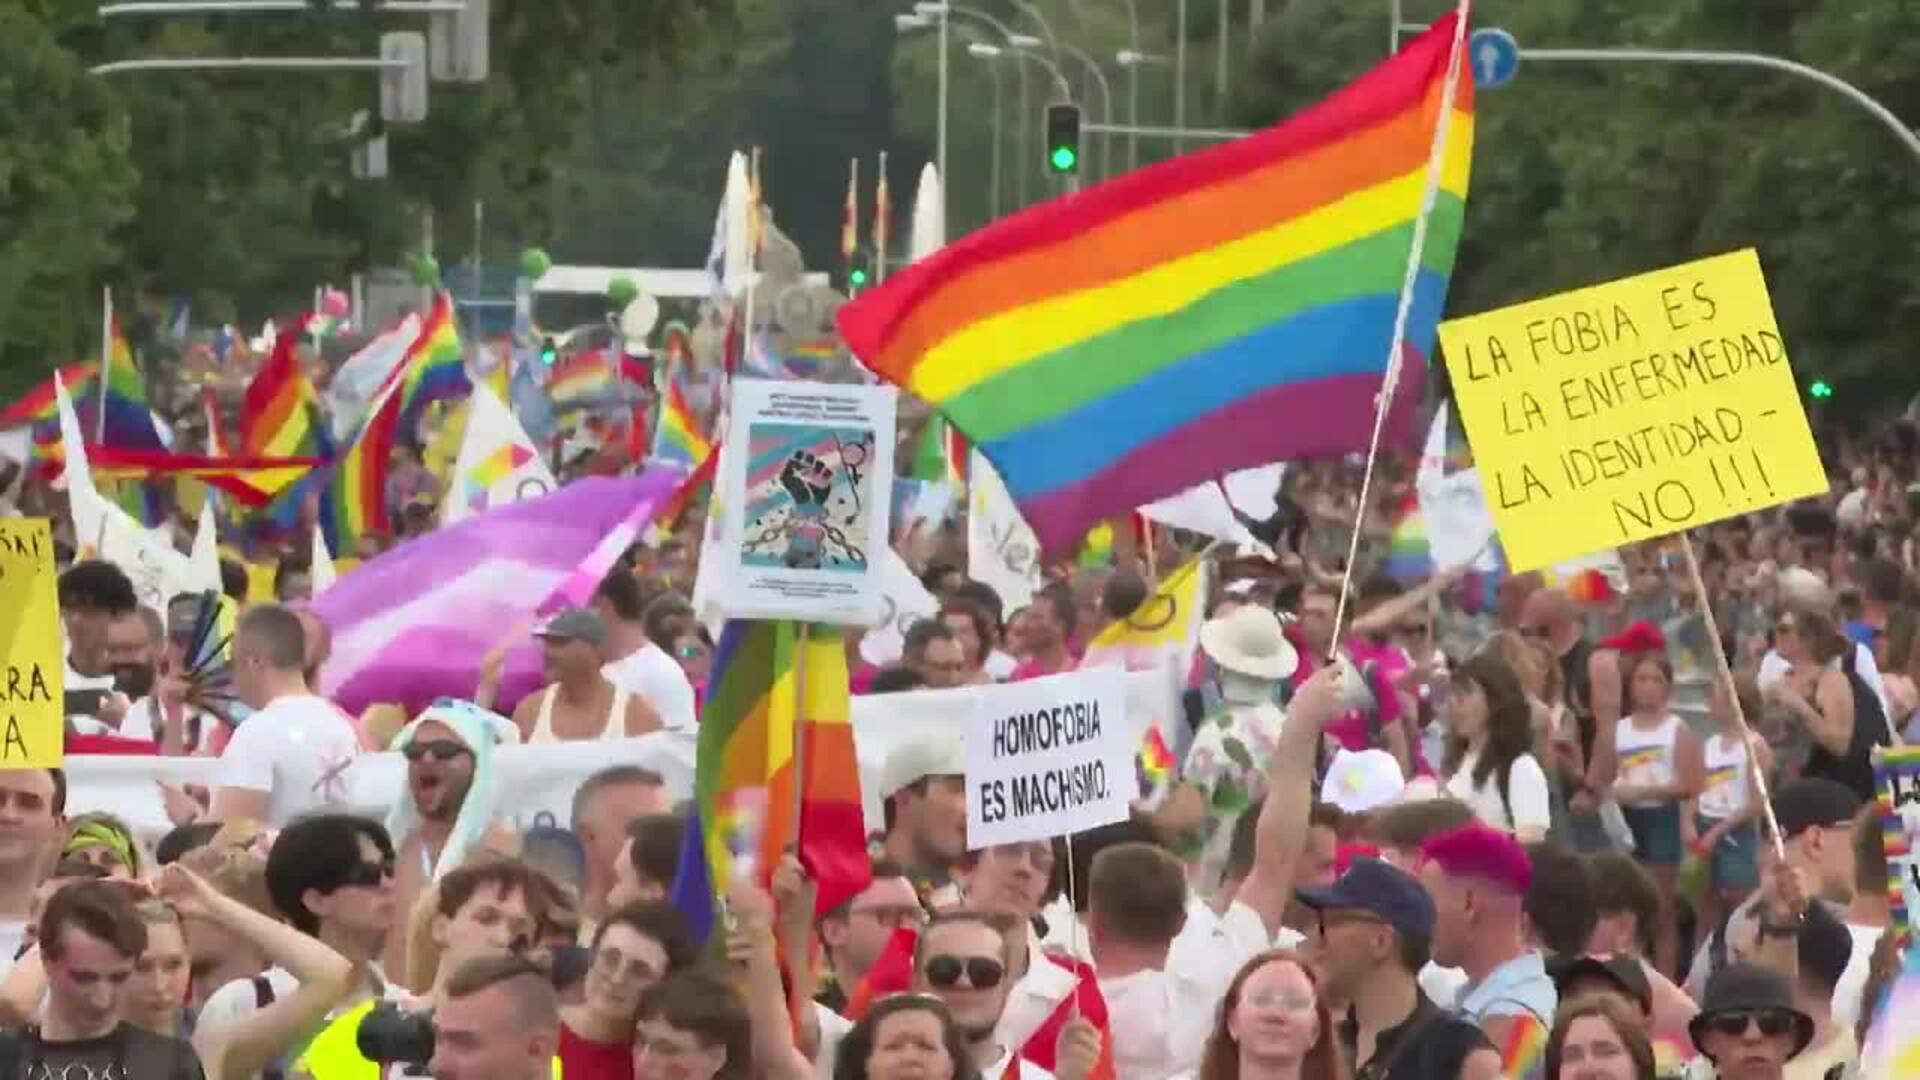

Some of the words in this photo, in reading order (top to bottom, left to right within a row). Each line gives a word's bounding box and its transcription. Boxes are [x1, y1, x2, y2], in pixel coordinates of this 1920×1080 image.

[1464, 335, 1512, 381] LA
[1525, 304, 1640, 365] FOBIA
[1661, 281, 1717, 331] ES
[1501, 391, 1546, 436] LA
[1559, 330, 1785, 421] ENFERMEDAD
[1495, 463, 1553, 510] LA
[1560, 407, 1743, 490] IDENTIDAD
[1611, 479, 1697, 537] NO
[0, 661, 52, 702] RA
[993, 698, 1101, 758] HOMOFOBIA
[980, 780, 1006, 823] ES
[1011, 759, 1110, 817] MACHISMO.
